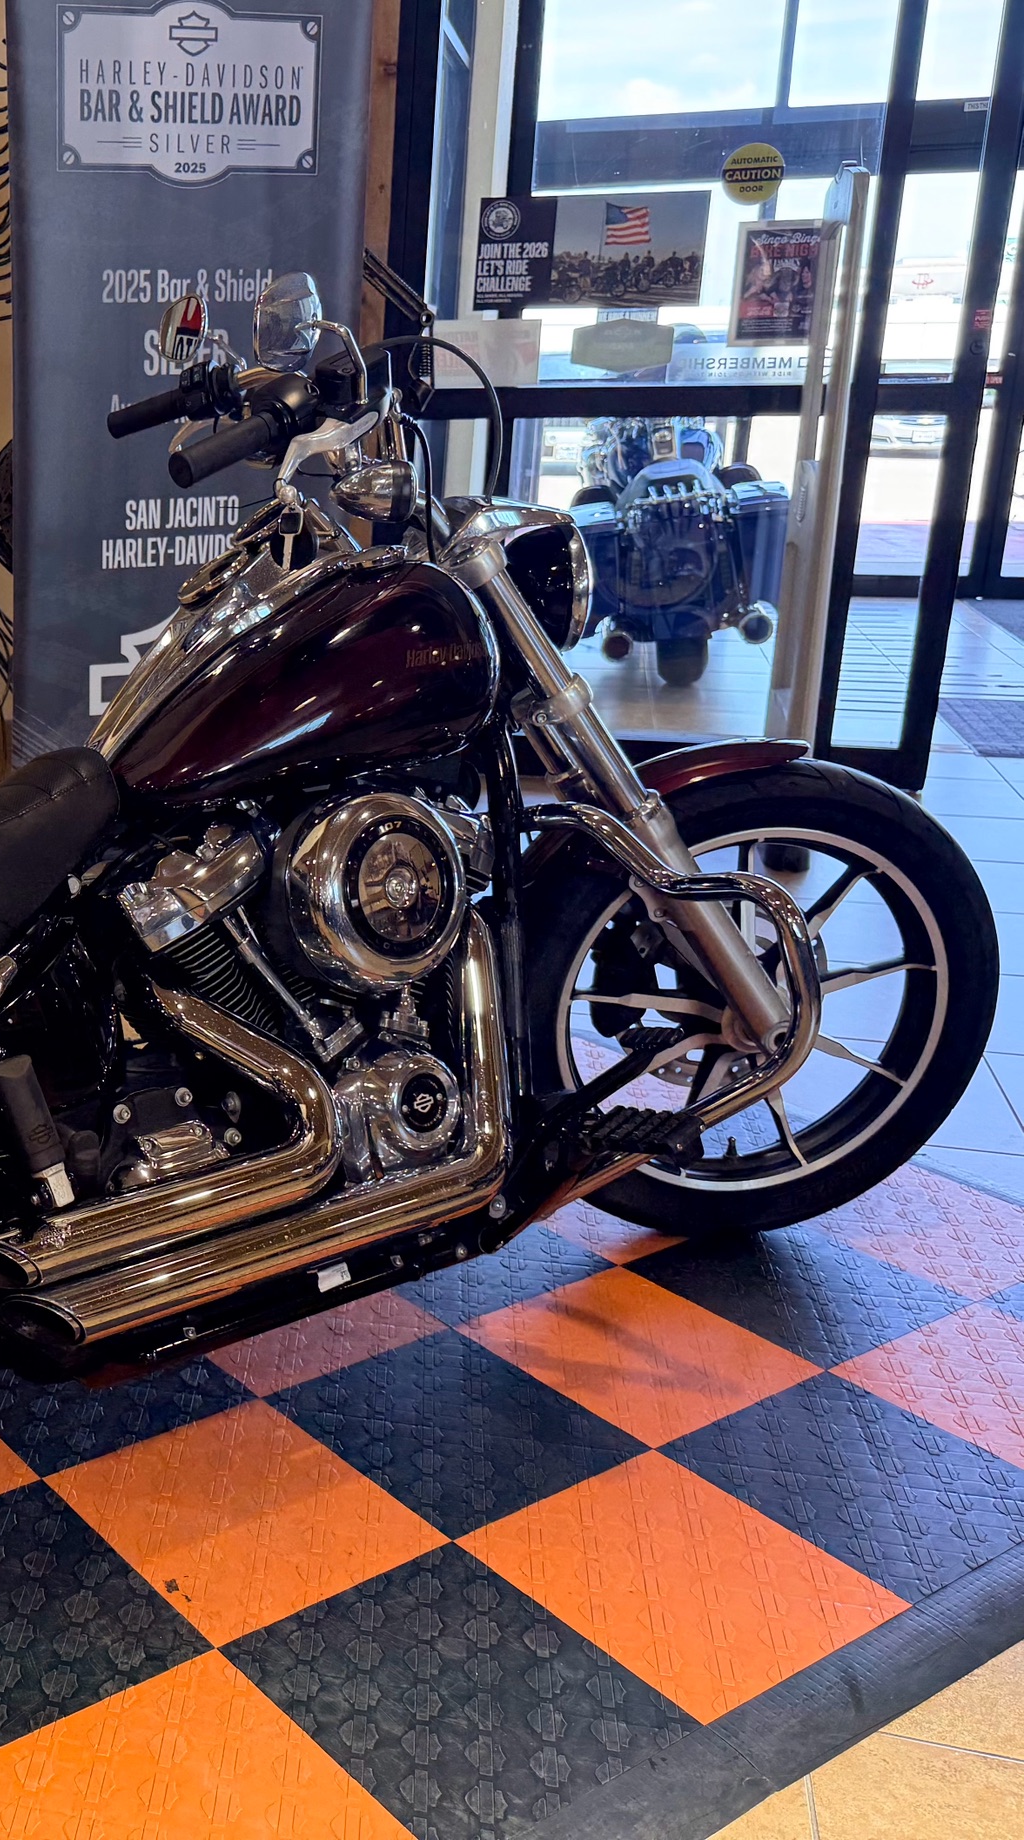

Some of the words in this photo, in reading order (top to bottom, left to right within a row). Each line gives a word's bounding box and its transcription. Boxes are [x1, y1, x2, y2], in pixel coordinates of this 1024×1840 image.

[79, 59, 303, 90] HARLEY-DAVIDSON
[79, 89, 121, 123] BAR
[128, 90, 144, 123] &
[150, 90, 224, 124] SHIELD
[229, 94, 302, 127] AWARD
[149, 133, 231, 154] SILVER
[174, 162, 207, 174] 2025
[731, 156, 779, 165] AUTOMATIC
[725, 168, 782, 181] CAUTION
[739, 185, 763, 193] DOOR
[478, 243, 502, 259] JOIN
[503, 243, 522, 259] THE
[522, 242, 549, 258] 2026
[477, 260, 504, 276] LET'S
[506, 260, 529, 275] RIDE
[102, 269, 151, 303] 2025
[157, 270, 190, 303] Bar
[195, 270, 209, 302] &
[214, 269, 272, 302] Shield
[476, 276, 532, 293] CHALLENGE
[126, 499, 161, 531] SAN
[165, 495, 239, 530] JACINTO
